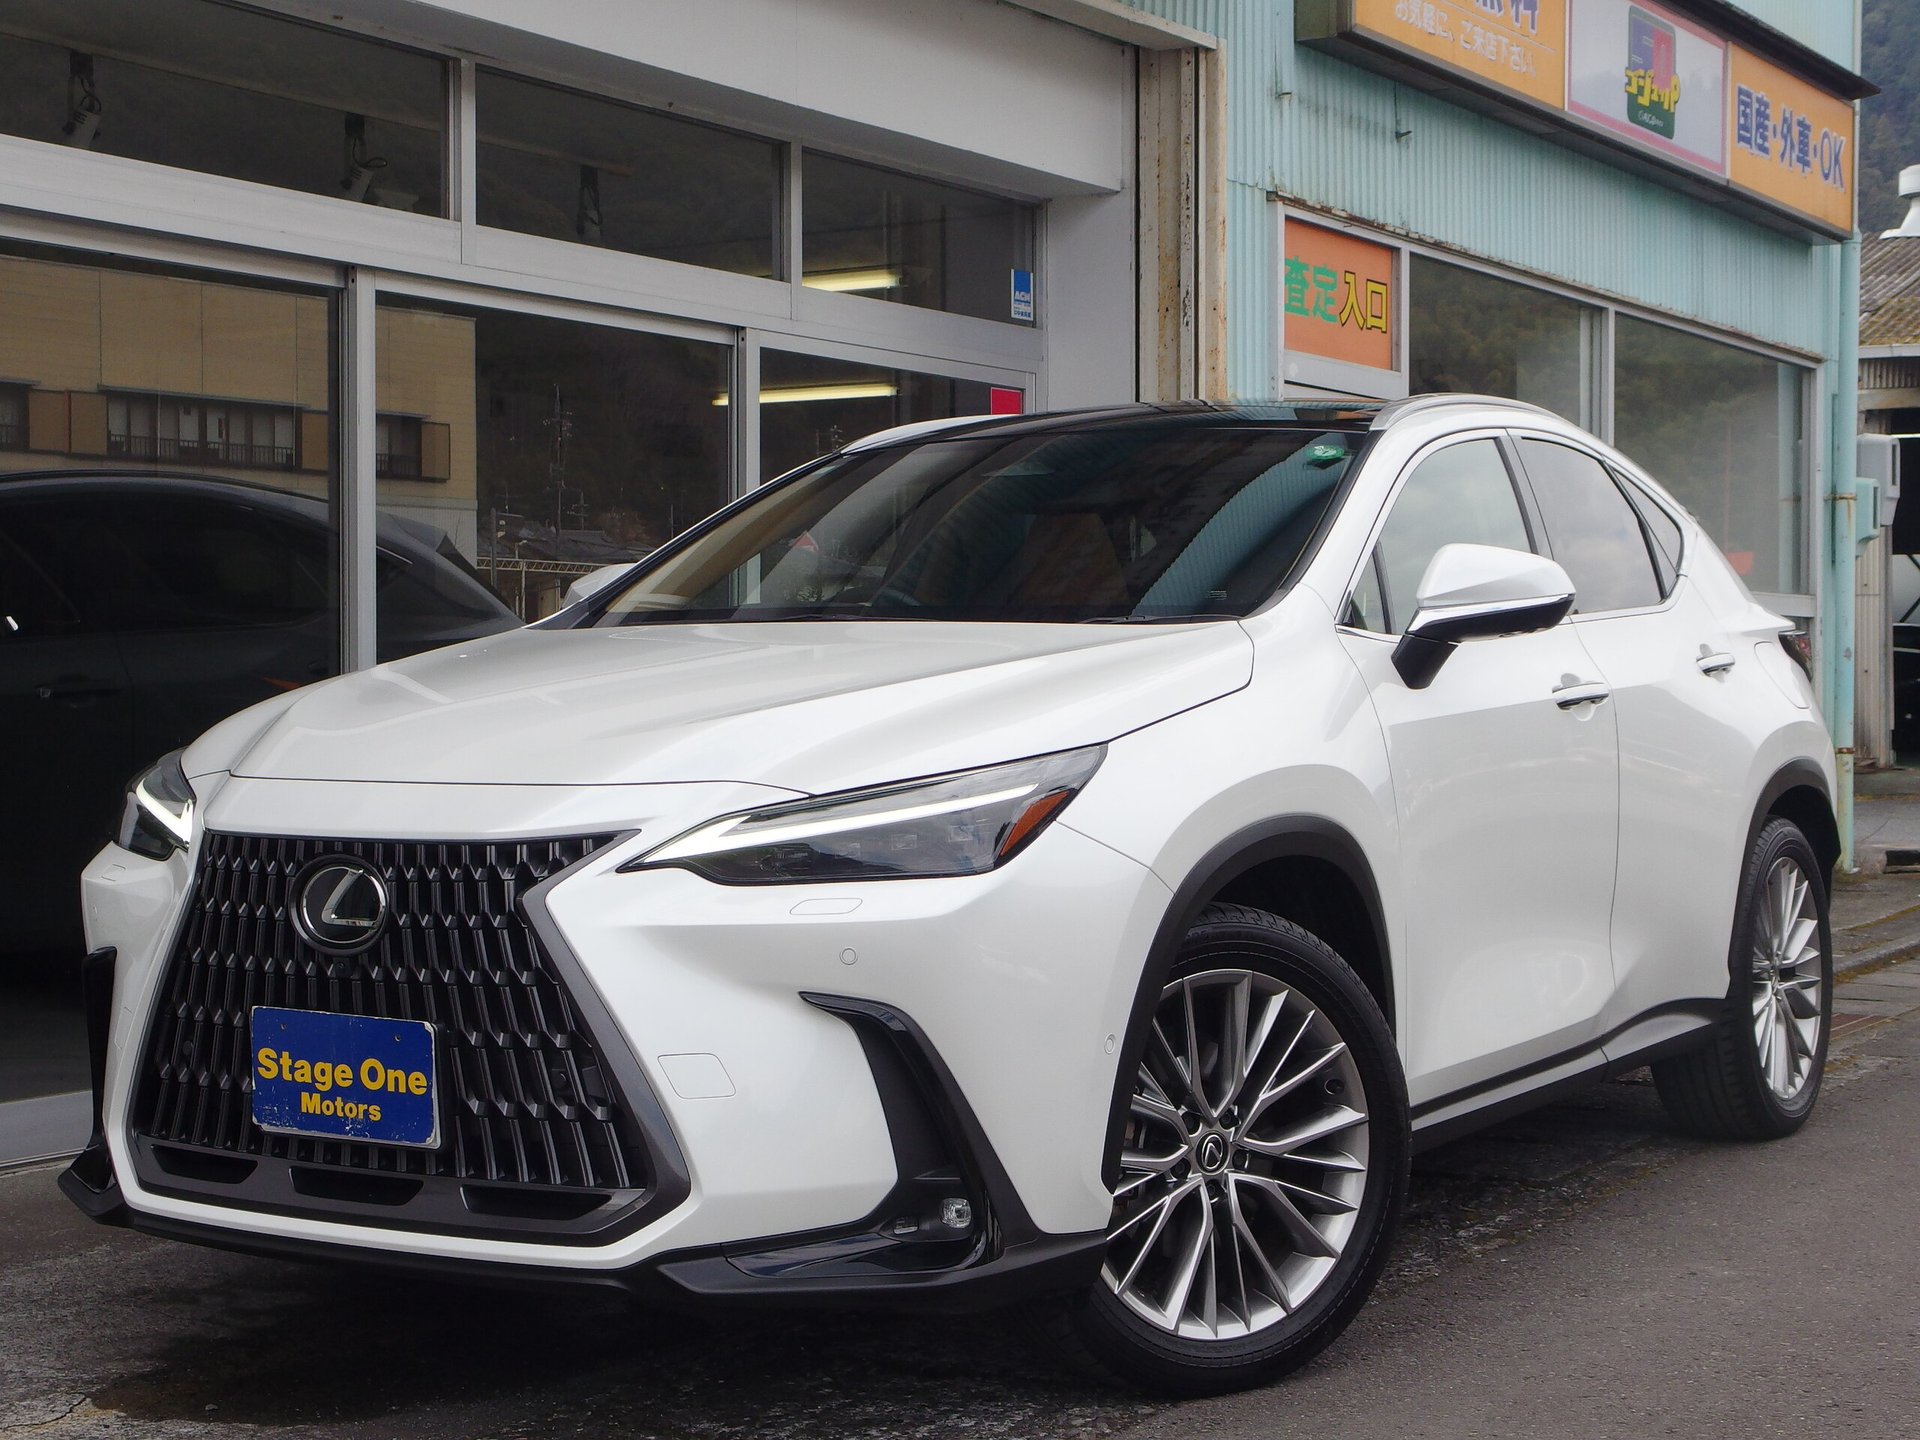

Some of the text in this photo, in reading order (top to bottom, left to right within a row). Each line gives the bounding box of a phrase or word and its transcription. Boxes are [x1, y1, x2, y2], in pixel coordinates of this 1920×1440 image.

[1285, 256, 1388, 334] 査定入口
[257, 1048, 428, 1096] Stage One
[301, 1091, 382, 1122] Motors
